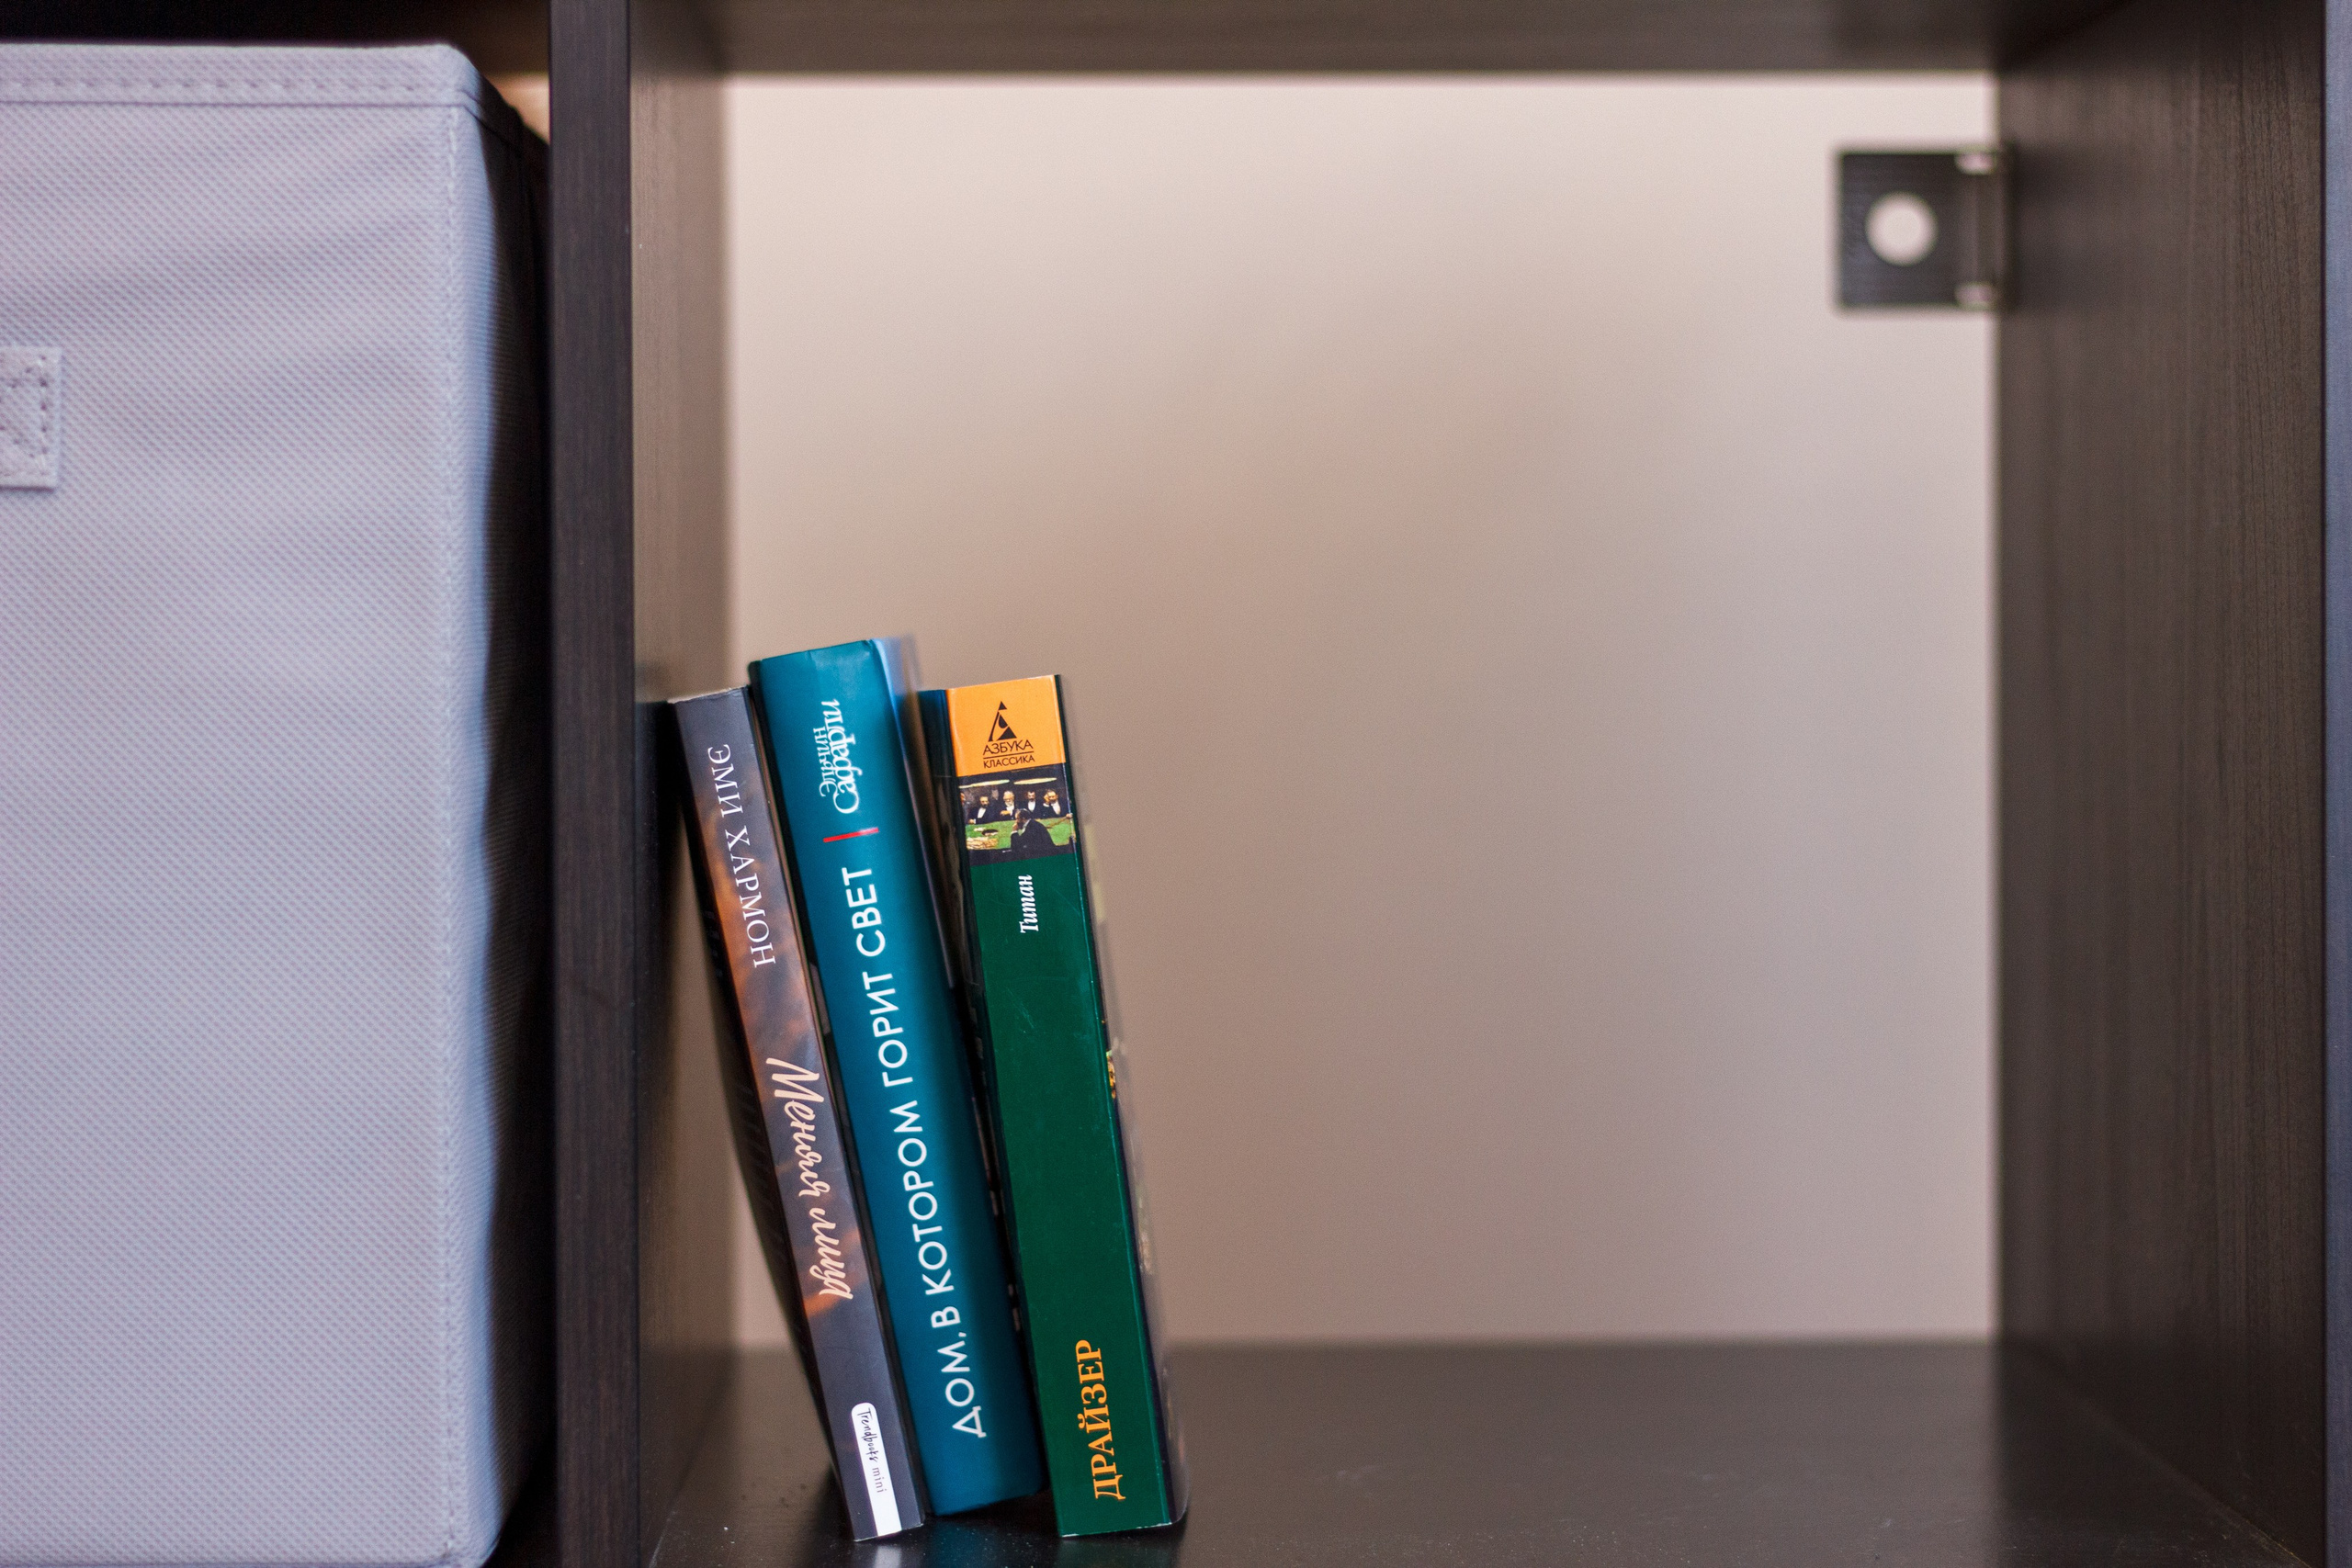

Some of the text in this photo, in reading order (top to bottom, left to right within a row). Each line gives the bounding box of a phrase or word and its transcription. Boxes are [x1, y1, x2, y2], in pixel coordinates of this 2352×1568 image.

[813, 726, 838, 797] Эльчин
[821, 698, 863, 814] Сафарли
[983, 739, 1034, 756] АЗБУКА
[983, 755, 1035, 769] КЛАССИКА
[707, 744, 776, 968] ЭМИ ХАРМОН
[1019, 874, 1039, 933] Титан
[765, 1057, 854, 1300] Меняя лица
[842, 867, 987, 1438] ДОМ, В КОТОРОМ ГОРИТ СВЕТ
[857, 1407, 888, 1494] Trendbooks mini
[1075, 1339, 1126, 1502] ДРАЙЗЕР
